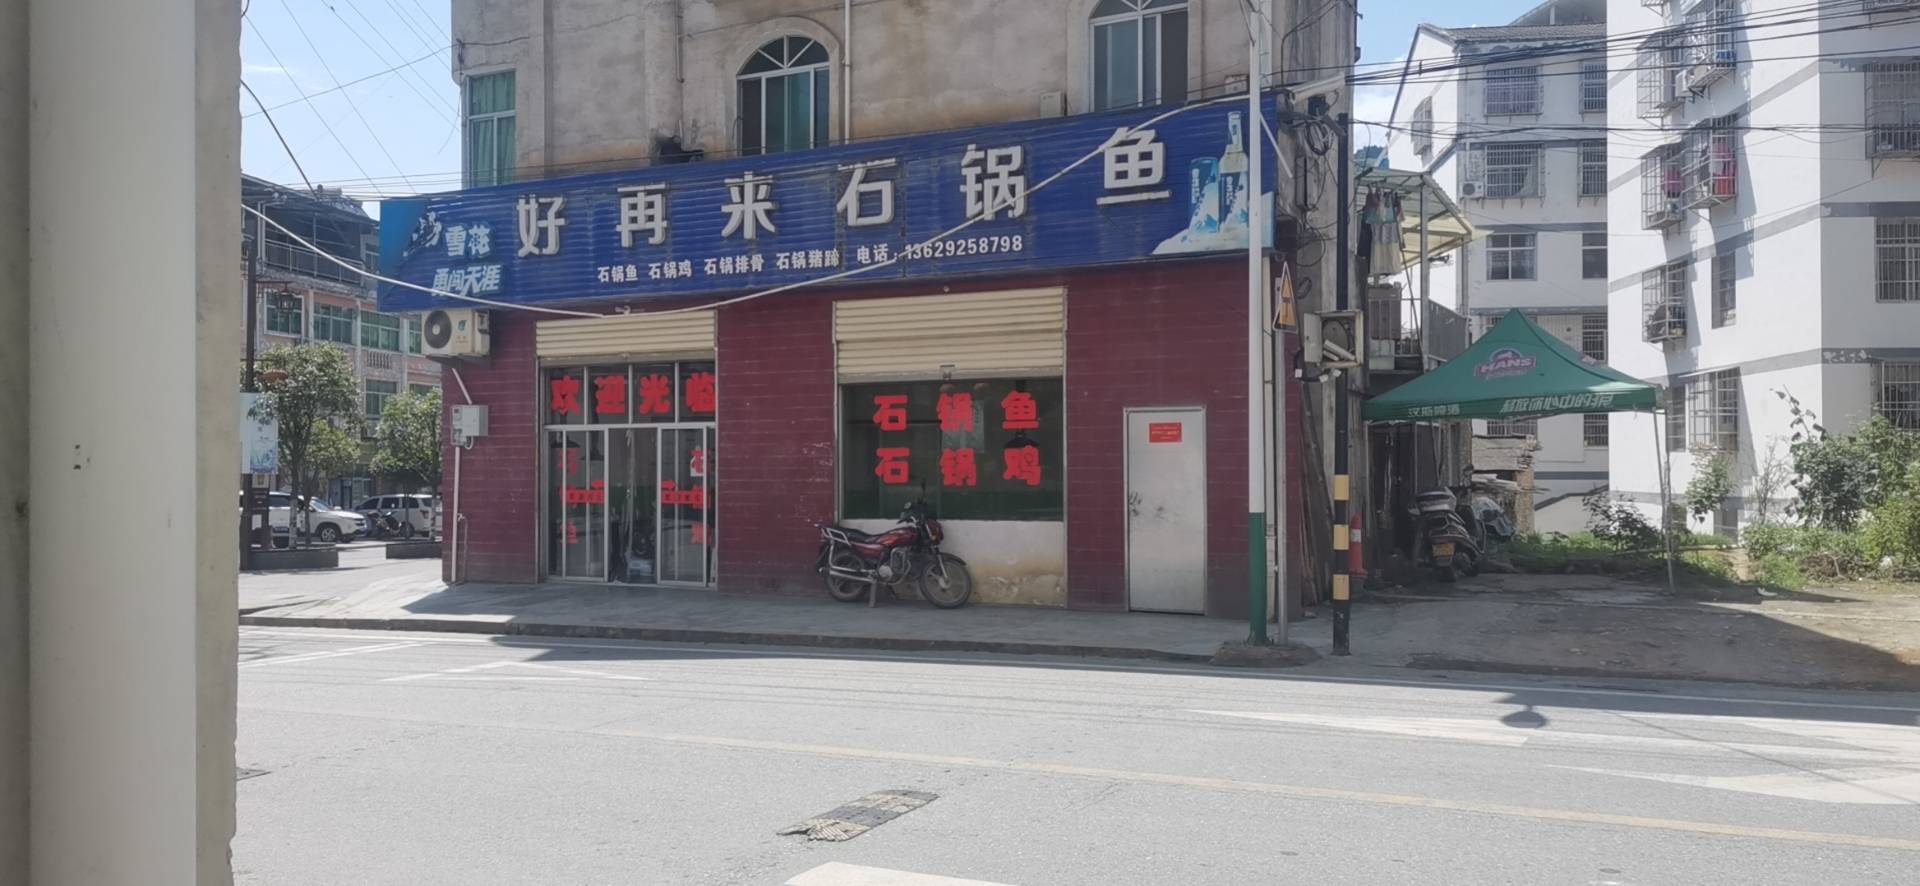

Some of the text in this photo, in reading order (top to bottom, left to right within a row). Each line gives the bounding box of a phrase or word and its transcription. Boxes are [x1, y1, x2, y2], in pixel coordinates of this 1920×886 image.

[517, 127, 1173, 258] 好再来石锅鱼
[445, 224, 491, 257] 雪花
[597, 264, 639, 284] 石锅鱼
[648, 260, 692, 280] 石锅鸡
[703, 254, 764, 275] 石锅排骨
[775, 251, 840, 270] 石锅猪蹄
[906, 235, 1023, 260] 13629258798
[432, 265, 501, 297] 勇闯天涯
[1480, 358, 1533, 374] HANS
[551, 374, 716, 415] 欢迎光临
[872, 390, 1040, 432] 石锅鱼
[1407, 403, 1460, 417] 汉斯啤酒
[874, 445, 1042, 487] 石锅鸡
